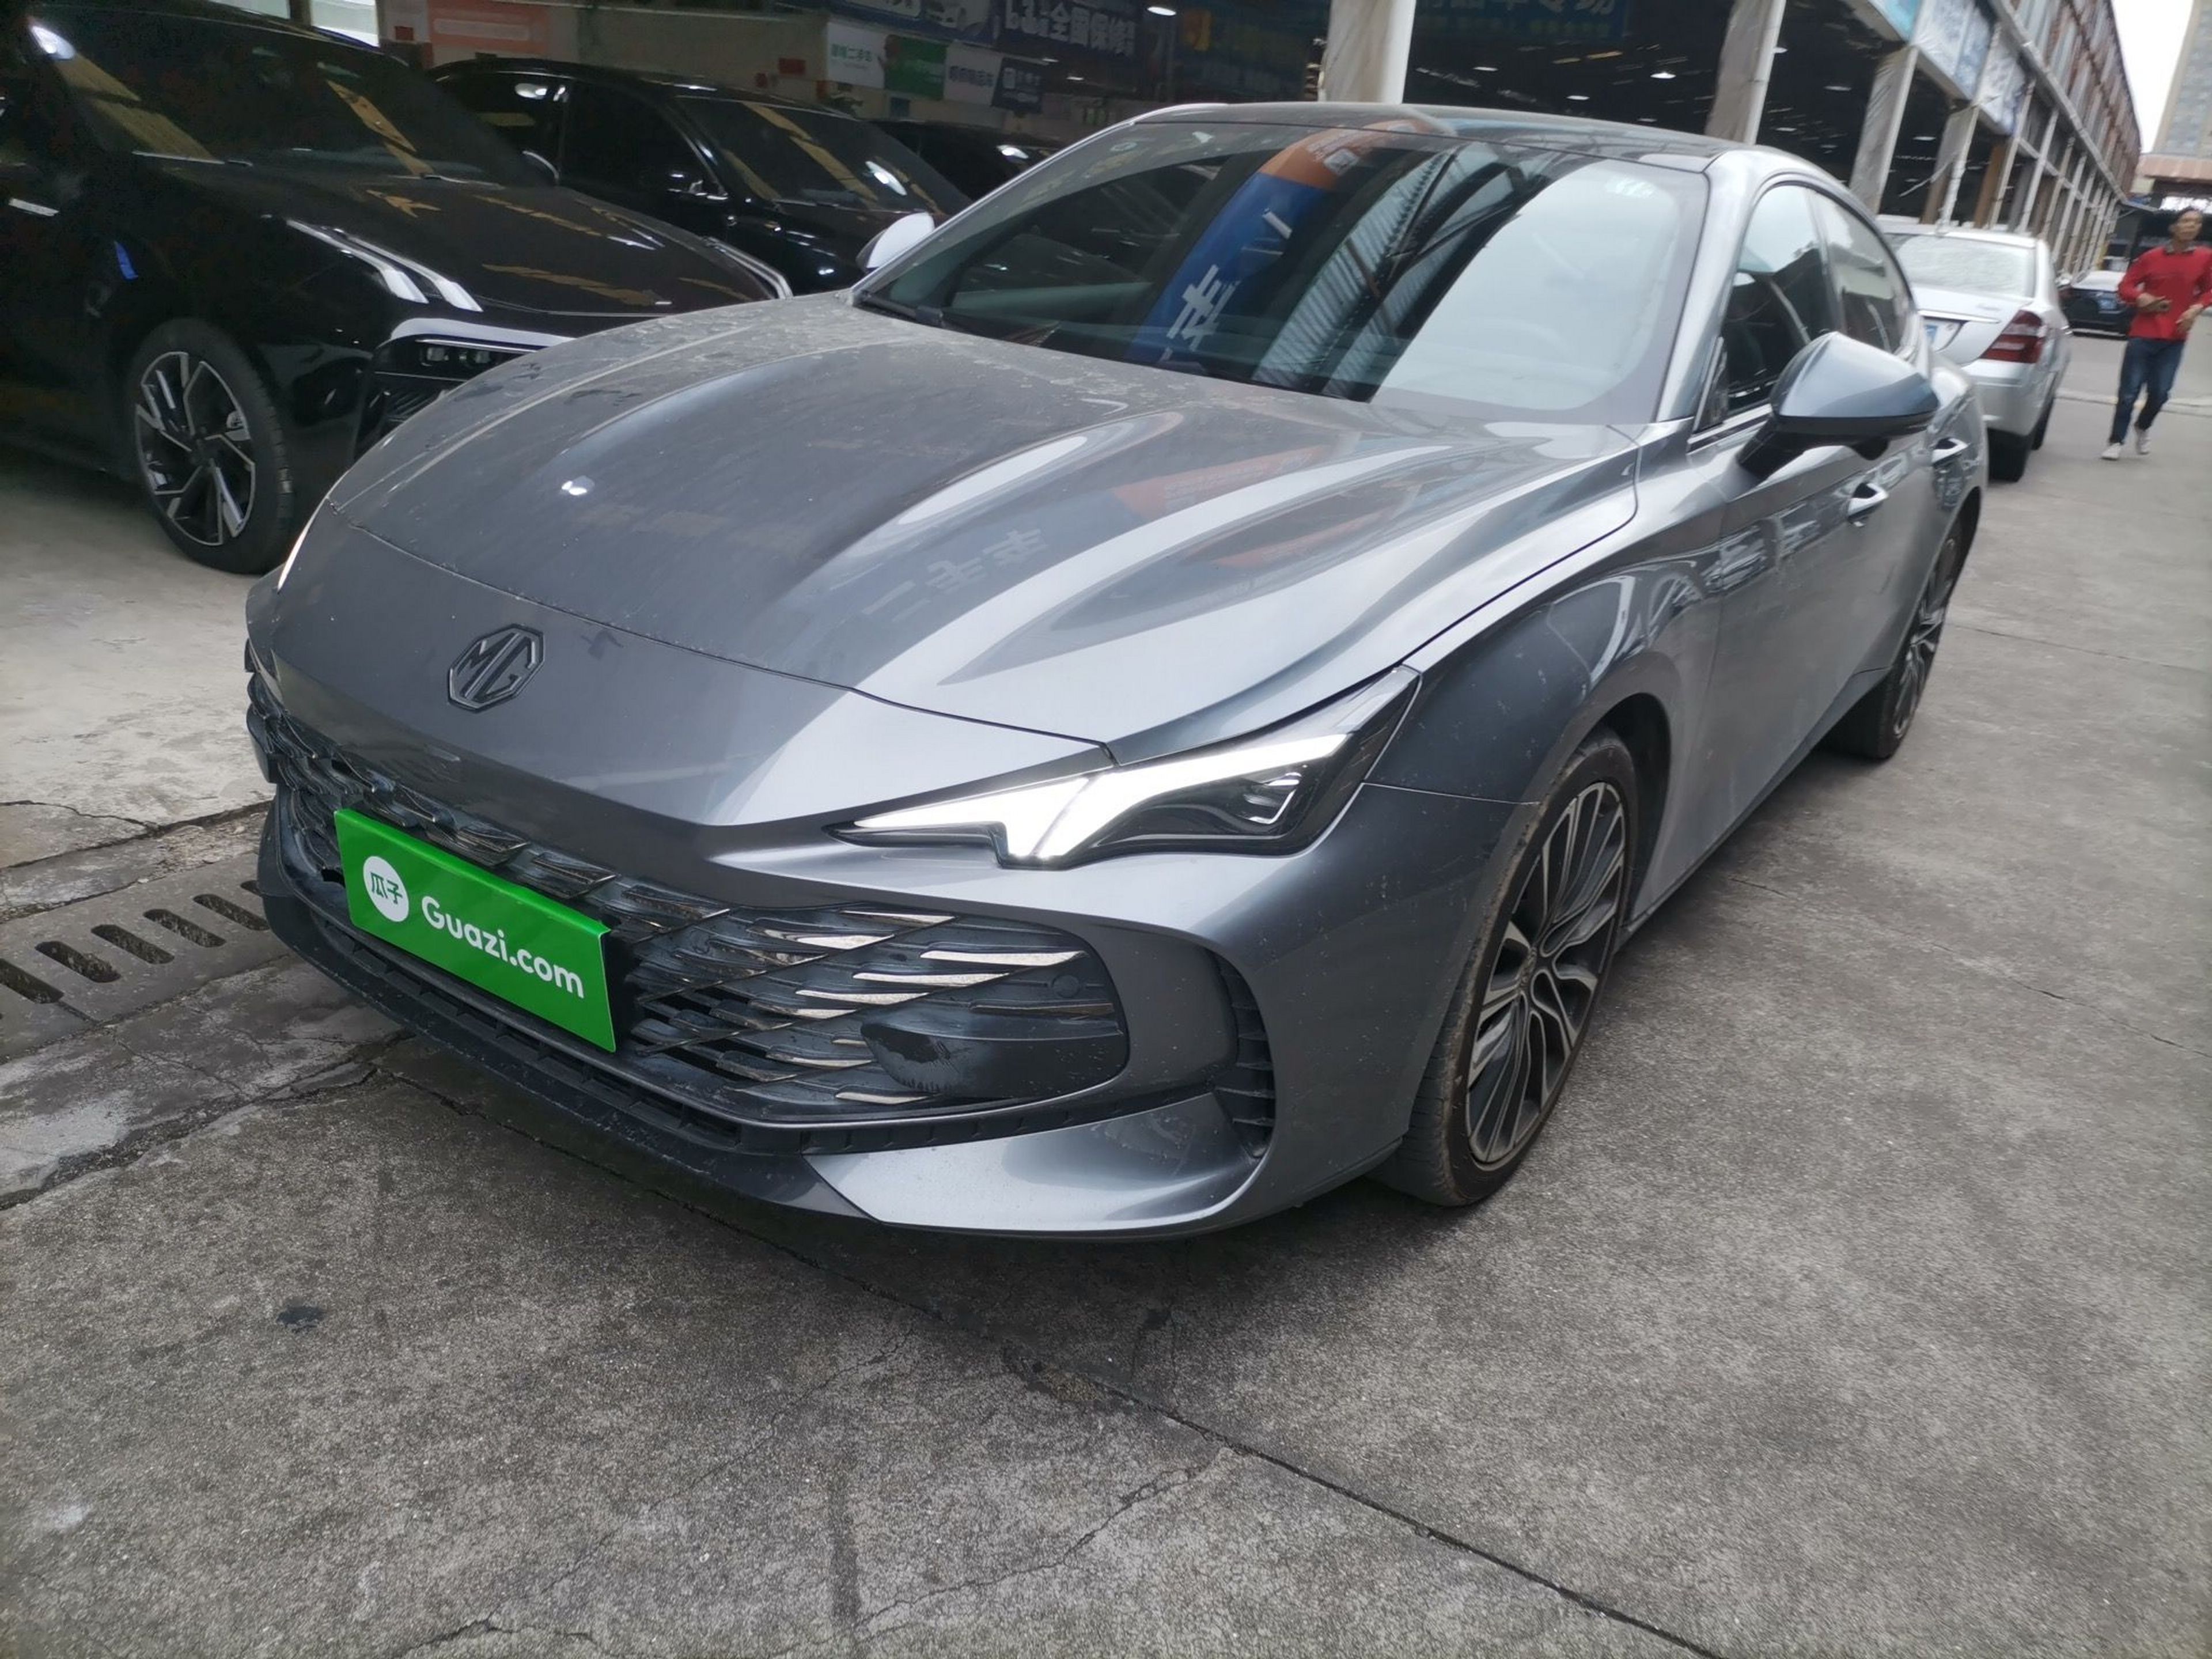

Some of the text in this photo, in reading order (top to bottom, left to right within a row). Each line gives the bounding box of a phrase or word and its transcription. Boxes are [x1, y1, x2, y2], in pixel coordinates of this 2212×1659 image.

[452, 627, 541, 709] MG
[370, 872, 403, 905] 瓜子
[421, 896, 585, 999] Guazi.com
